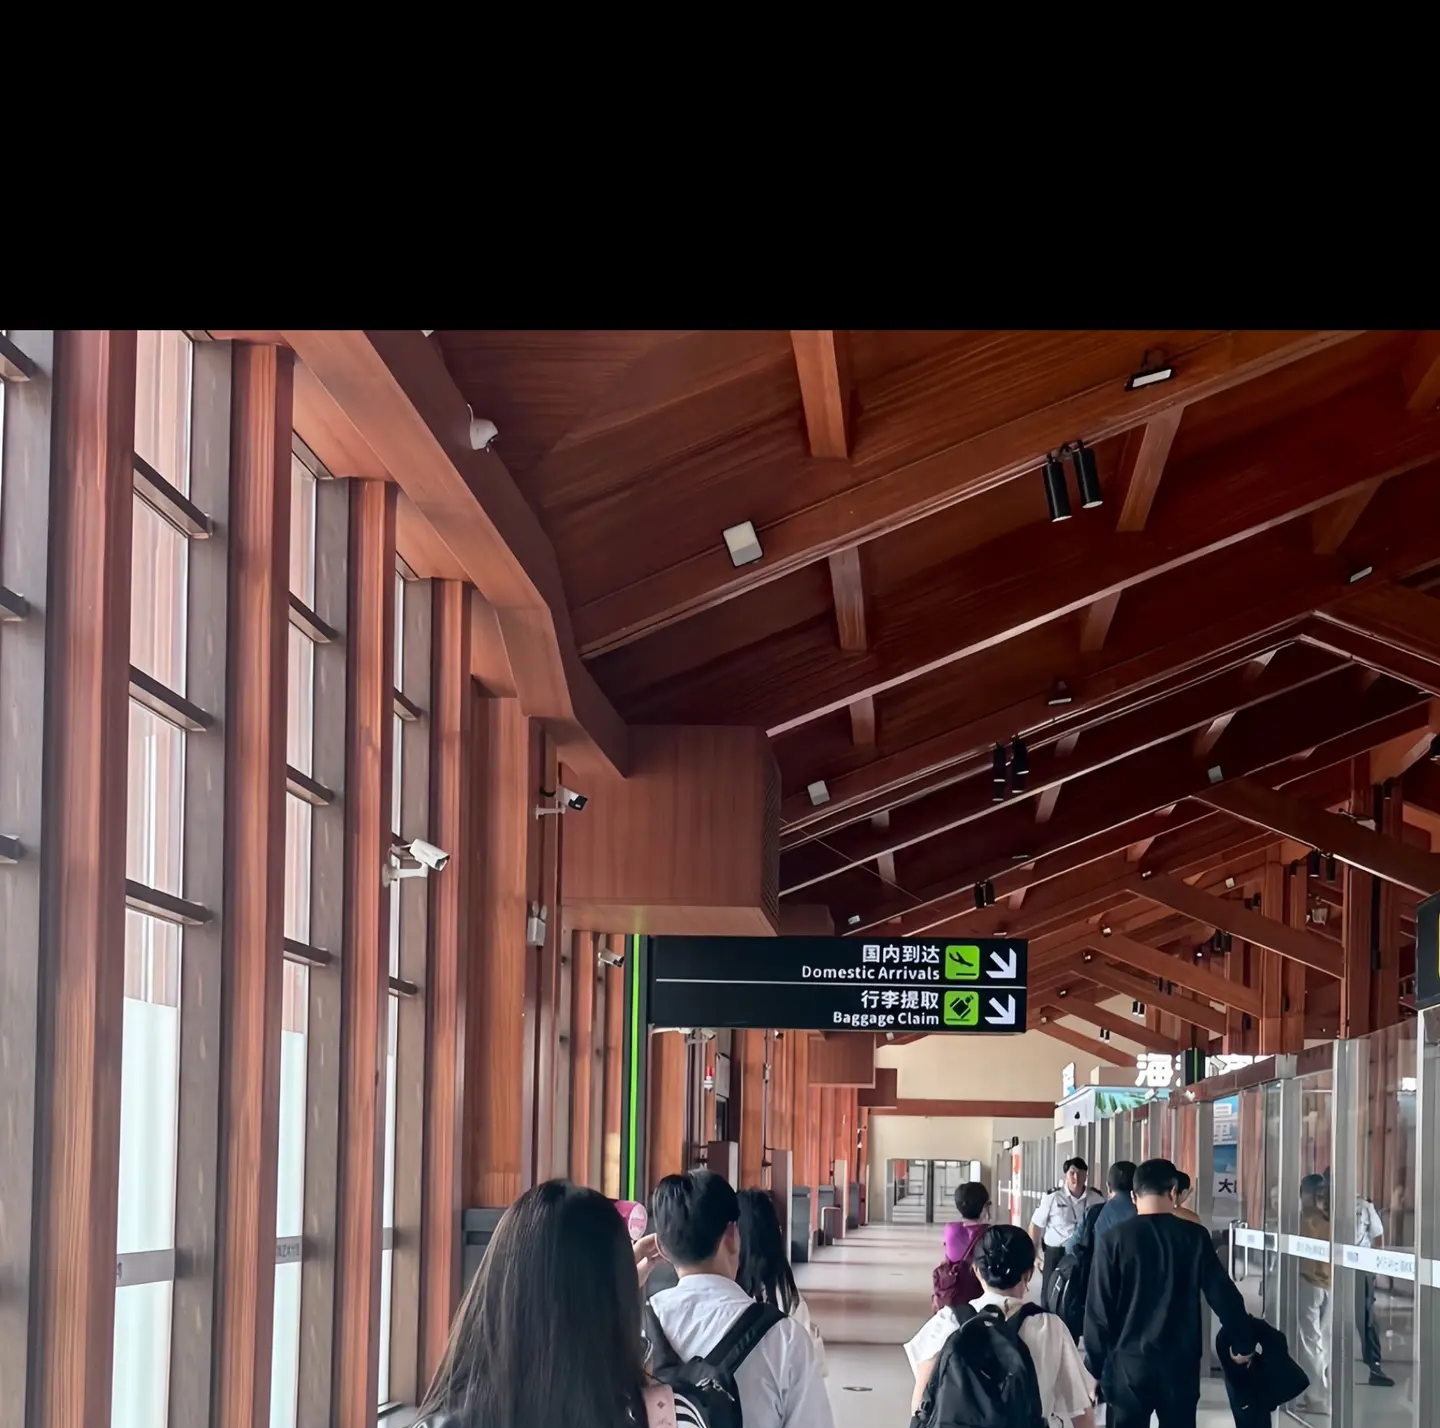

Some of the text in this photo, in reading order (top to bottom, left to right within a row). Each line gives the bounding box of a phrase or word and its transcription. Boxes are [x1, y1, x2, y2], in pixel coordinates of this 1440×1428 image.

[862, 944, 940, 963] 国内到达
[802, 965, 940, 980] Domestic Arrivals
[861, 989, 939, 1010] 行李提取
[833, 1011, 940, 1027] Baggage Claim
